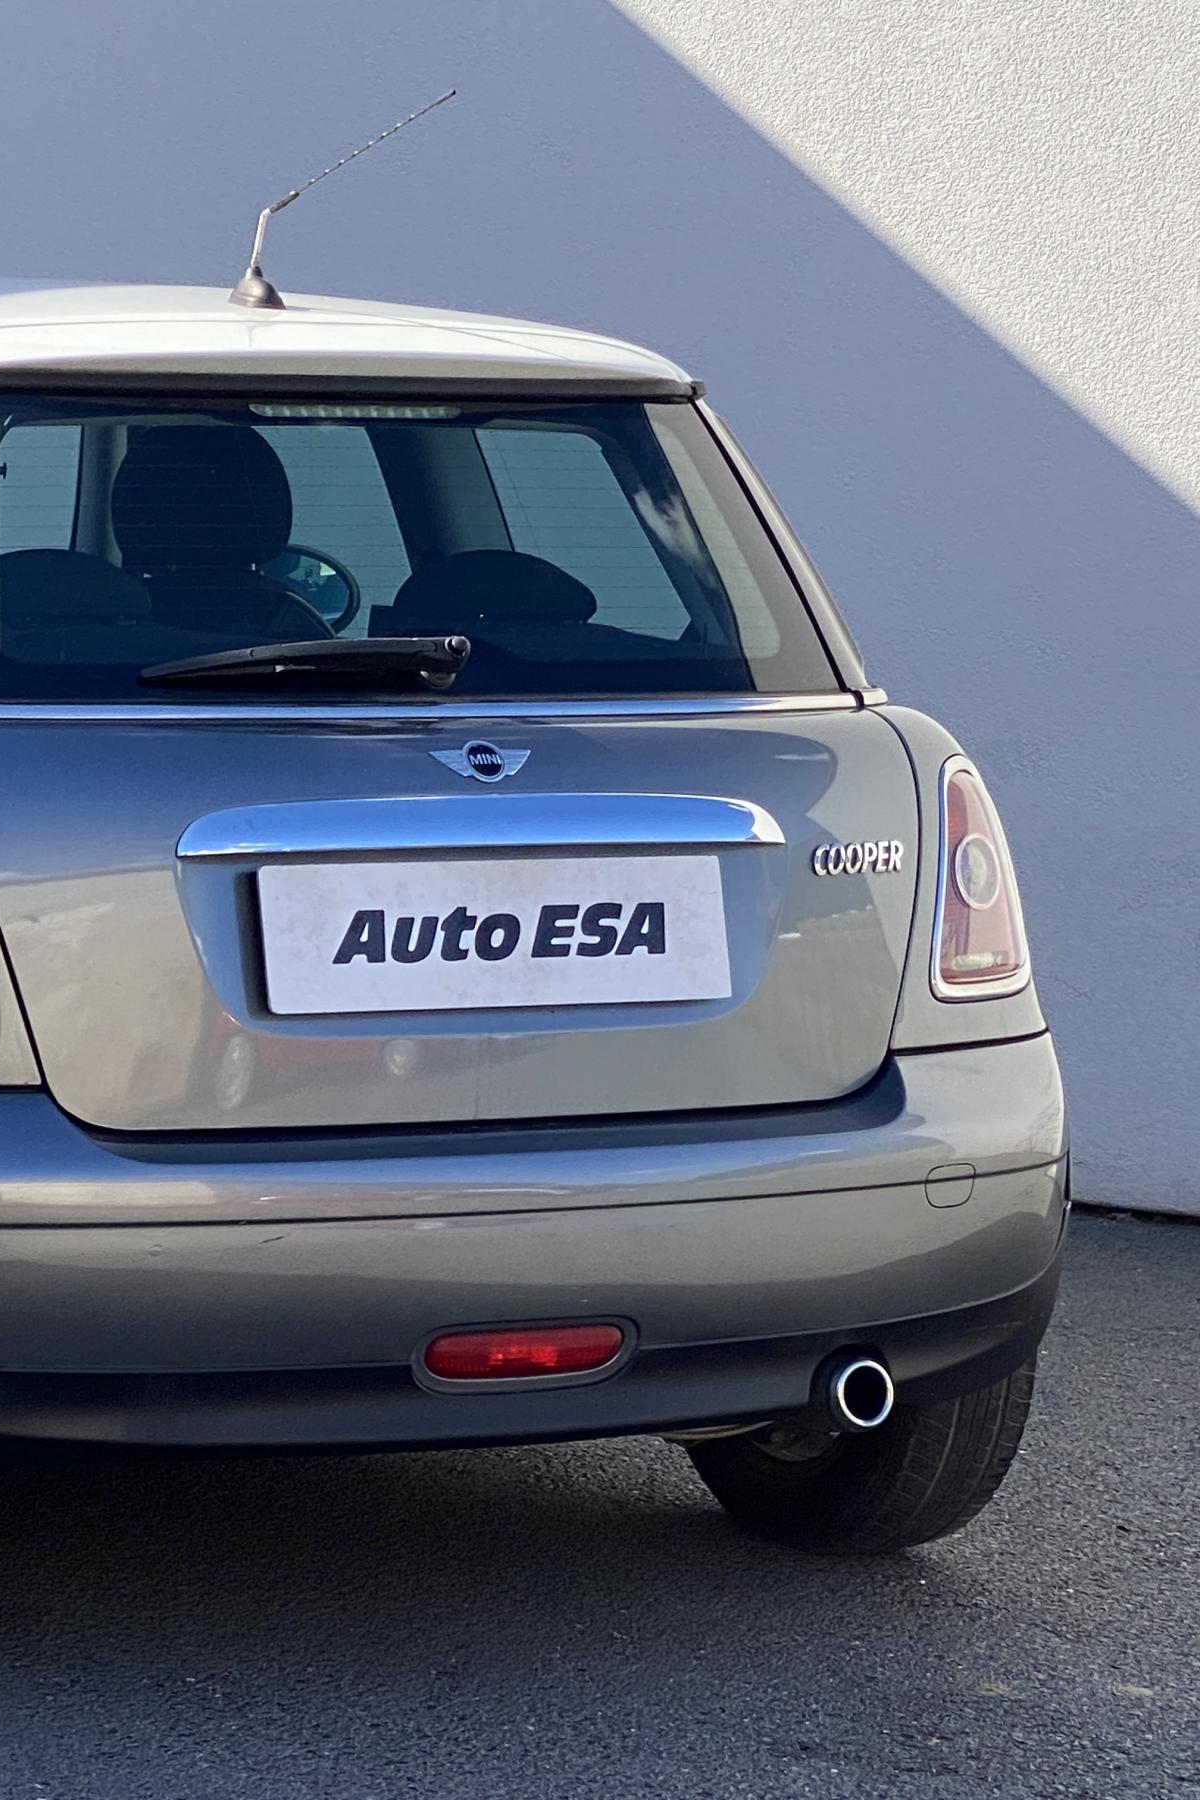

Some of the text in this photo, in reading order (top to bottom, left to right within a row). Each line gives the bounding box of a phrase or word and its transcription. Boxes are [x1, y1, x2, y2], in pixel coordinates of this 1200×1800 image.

[468, 753, 502, 766] MINI
[813, 840, 904, 876] COOPER
[332, 902, 666, 964] Auto ESA
